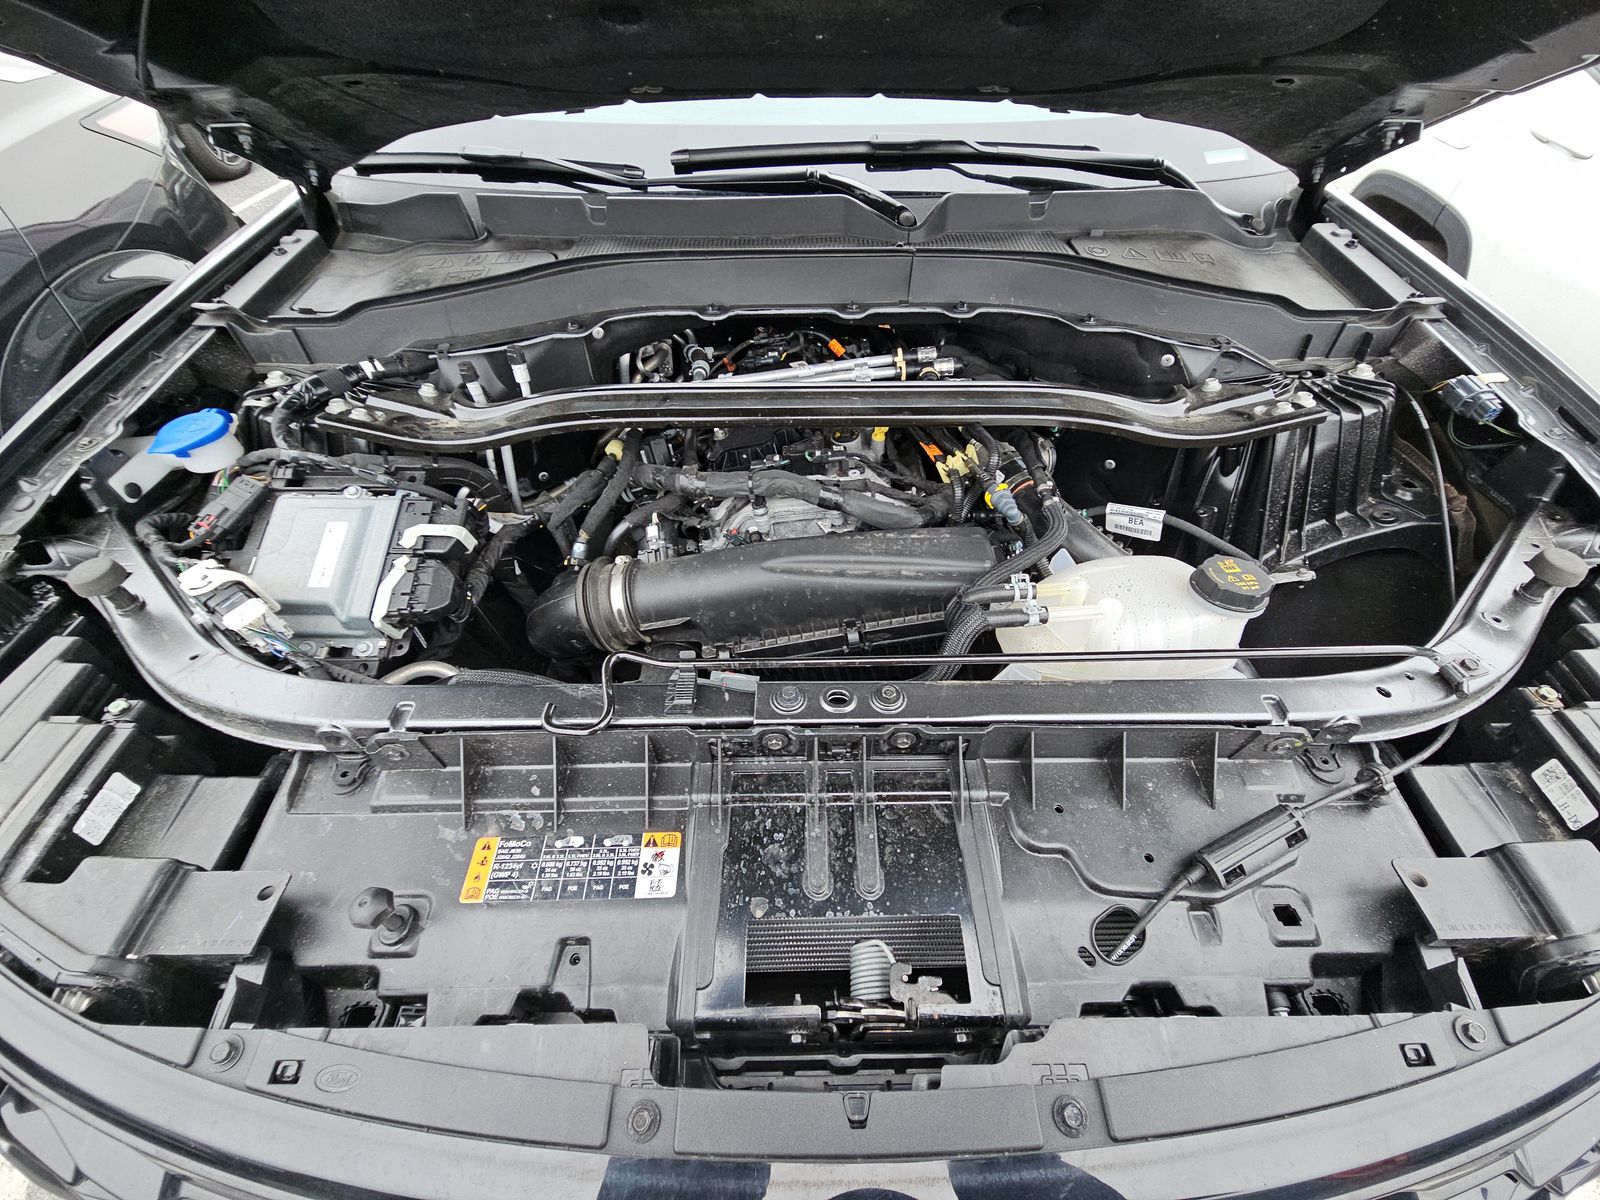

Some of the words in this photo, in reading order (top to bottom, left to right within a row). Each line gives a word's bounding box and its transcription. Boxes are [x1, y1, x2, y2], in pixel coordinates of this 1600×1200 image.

[1128, 517, 1144, 526] BEA
[499, 840, 531, 848] FoMoCo
[493, 862, 524, 870] R-1234yf
